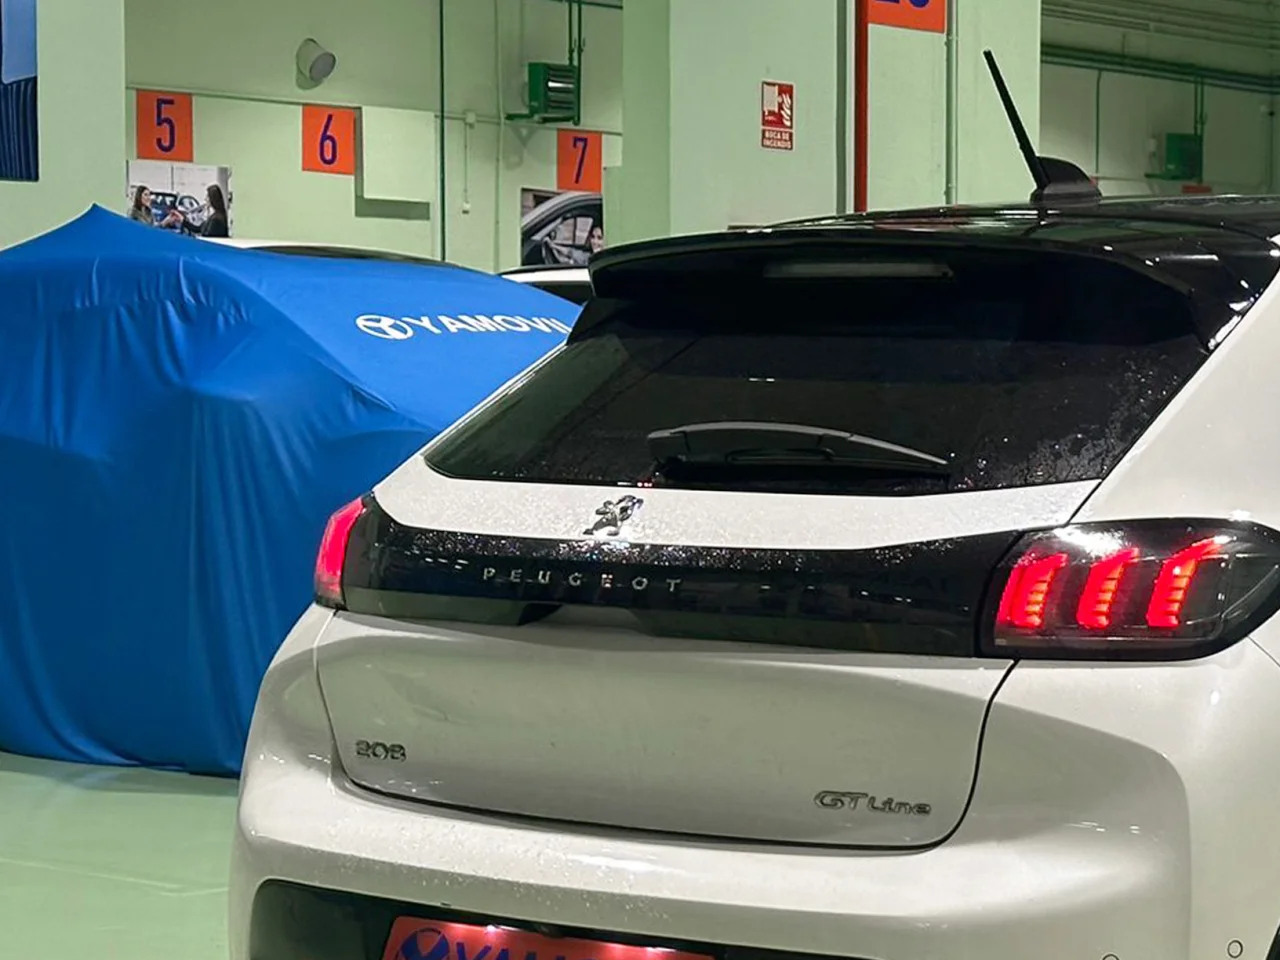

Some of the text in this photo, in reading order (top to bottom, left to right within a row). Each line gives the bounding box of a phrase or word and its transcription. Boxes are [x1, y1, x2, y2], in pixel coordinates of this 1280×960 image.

[156, 98, 175, 152] 5
[319, 113, 337, 166] 6
[572, 136, 589, 185] 7
[483, 566, 681, 592] PEUGEOT
[356, 739, 407, 761] 208
[813, 790, 932, 816] GT Line
